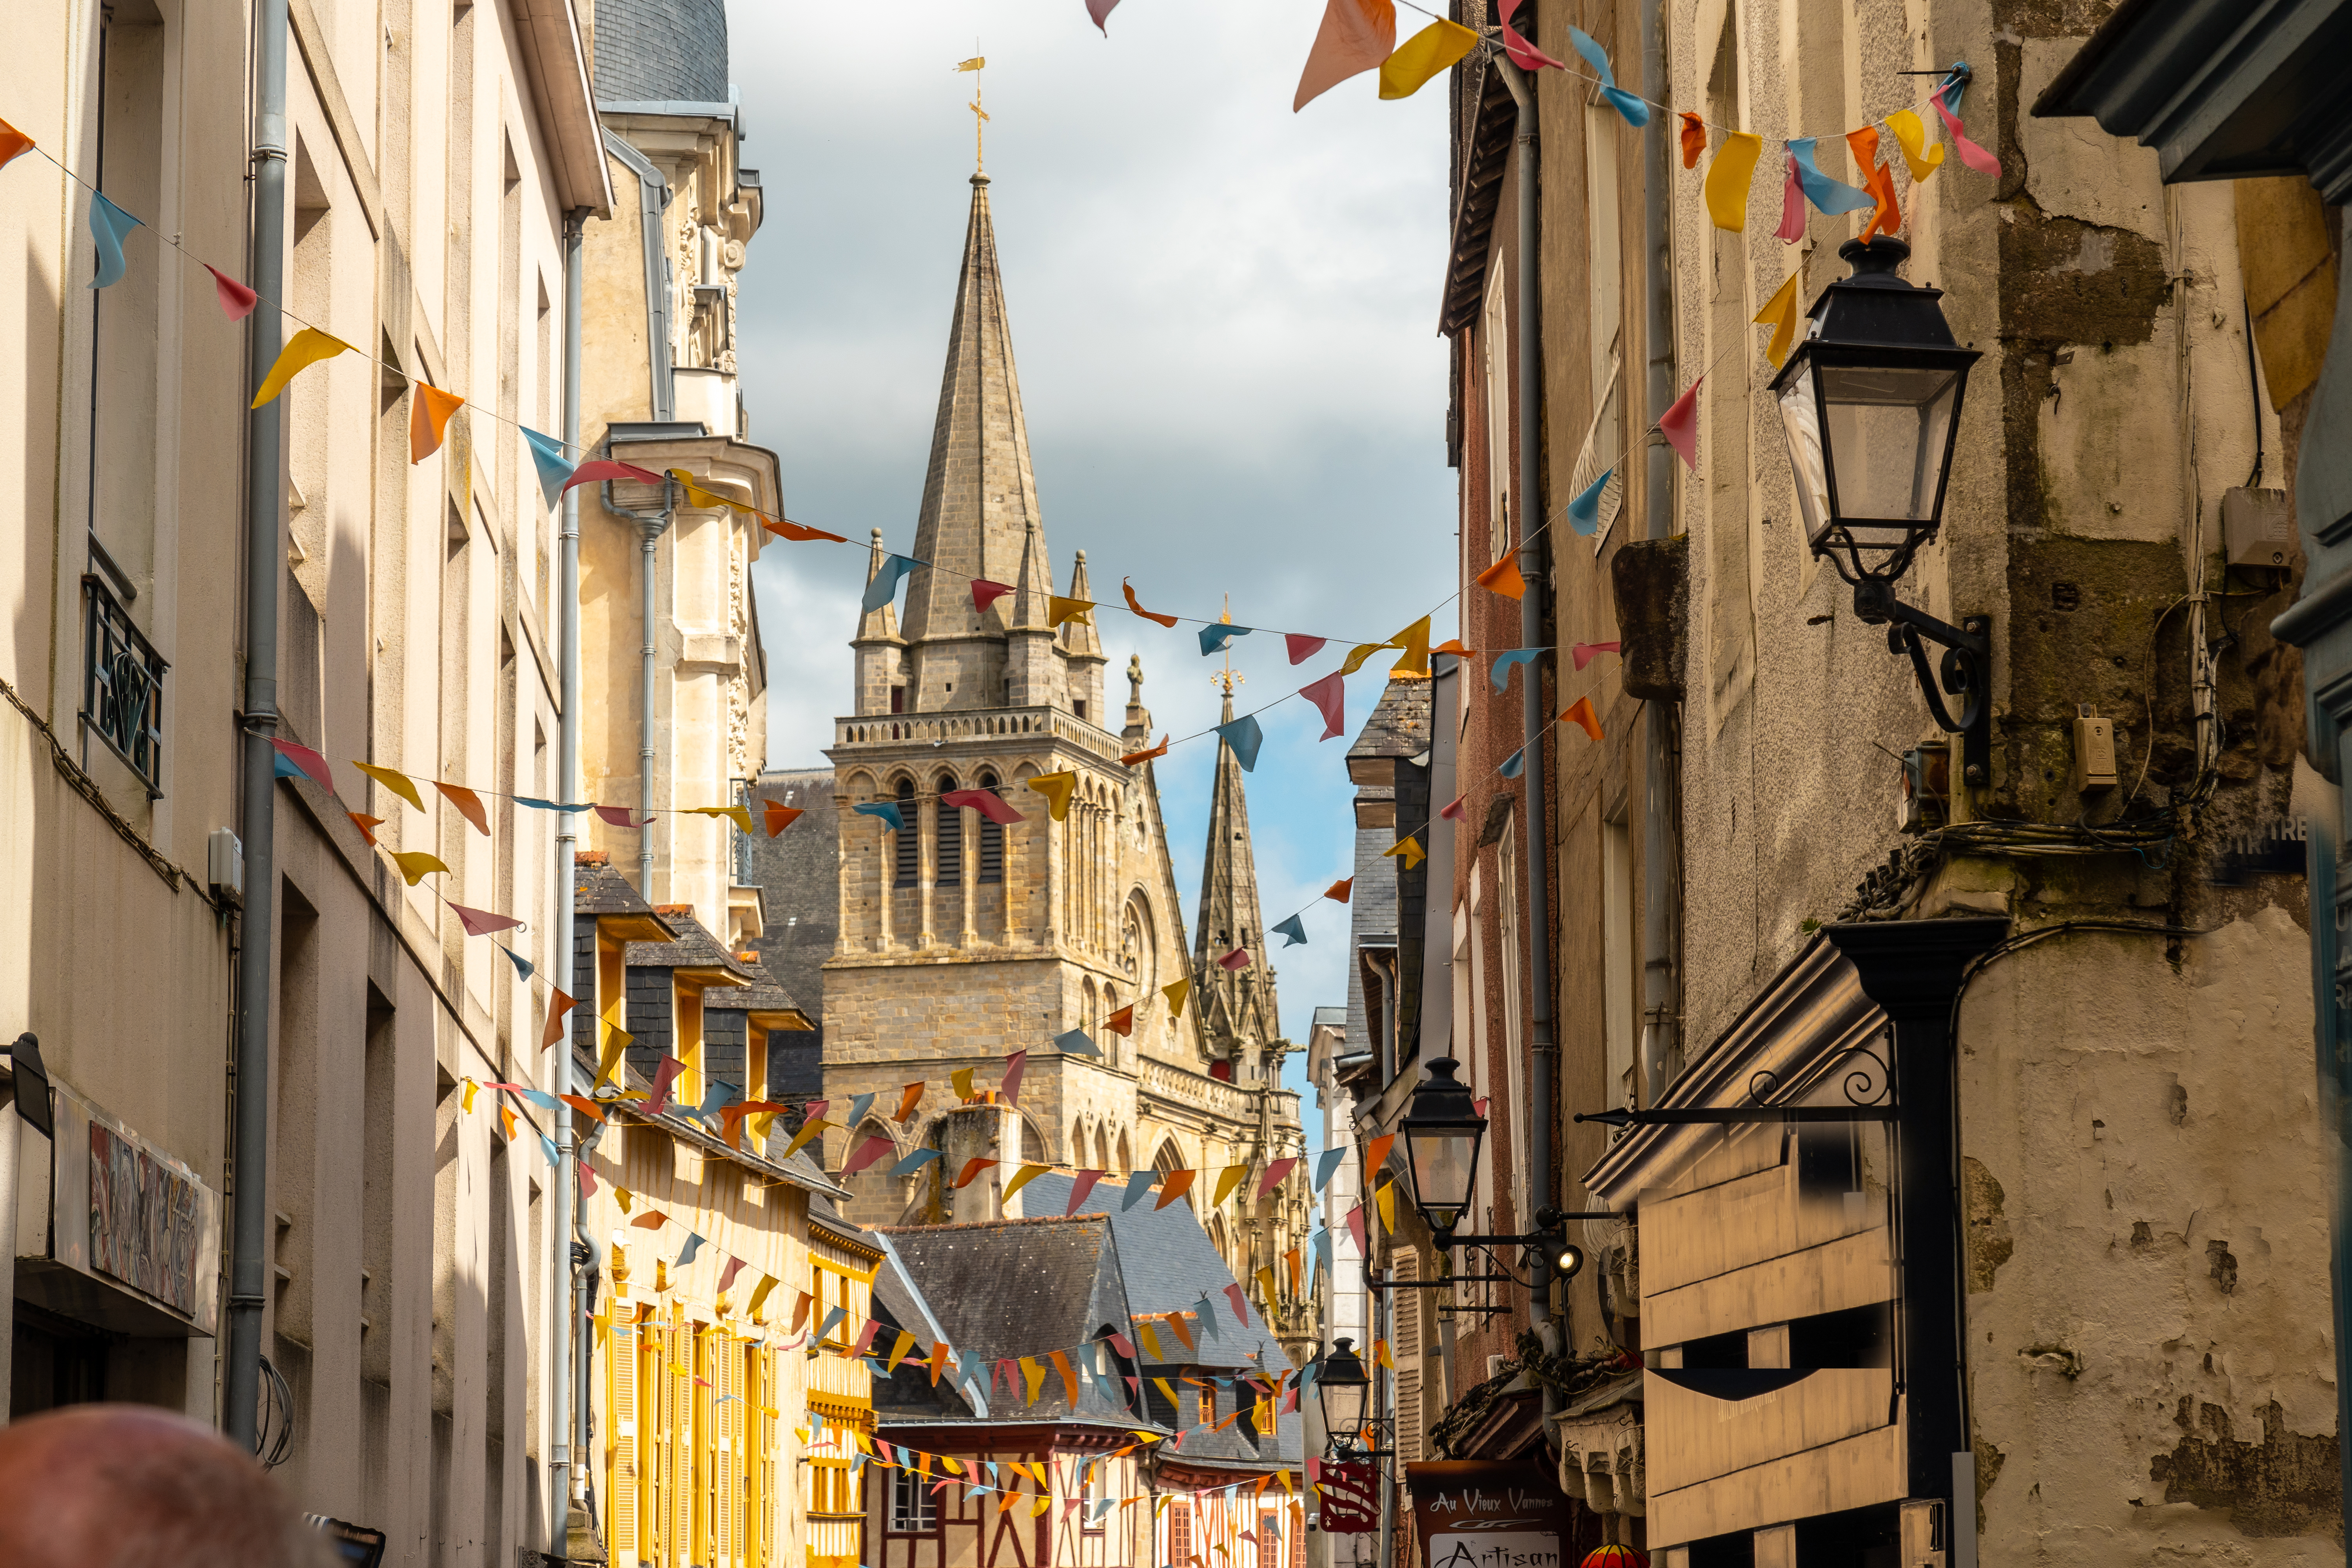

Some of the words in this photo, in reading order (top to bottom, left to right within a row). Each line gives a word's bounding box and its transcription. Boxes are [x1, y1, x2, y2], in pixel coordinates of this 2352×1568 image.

[1430, 1492, 1457, 1514] Au
[1463, 1488, 1501, 1515] Vieux
[1508, 1487, 1553, 1514] Vannes
[1434, 1540, 1558, 1568] Artisan
